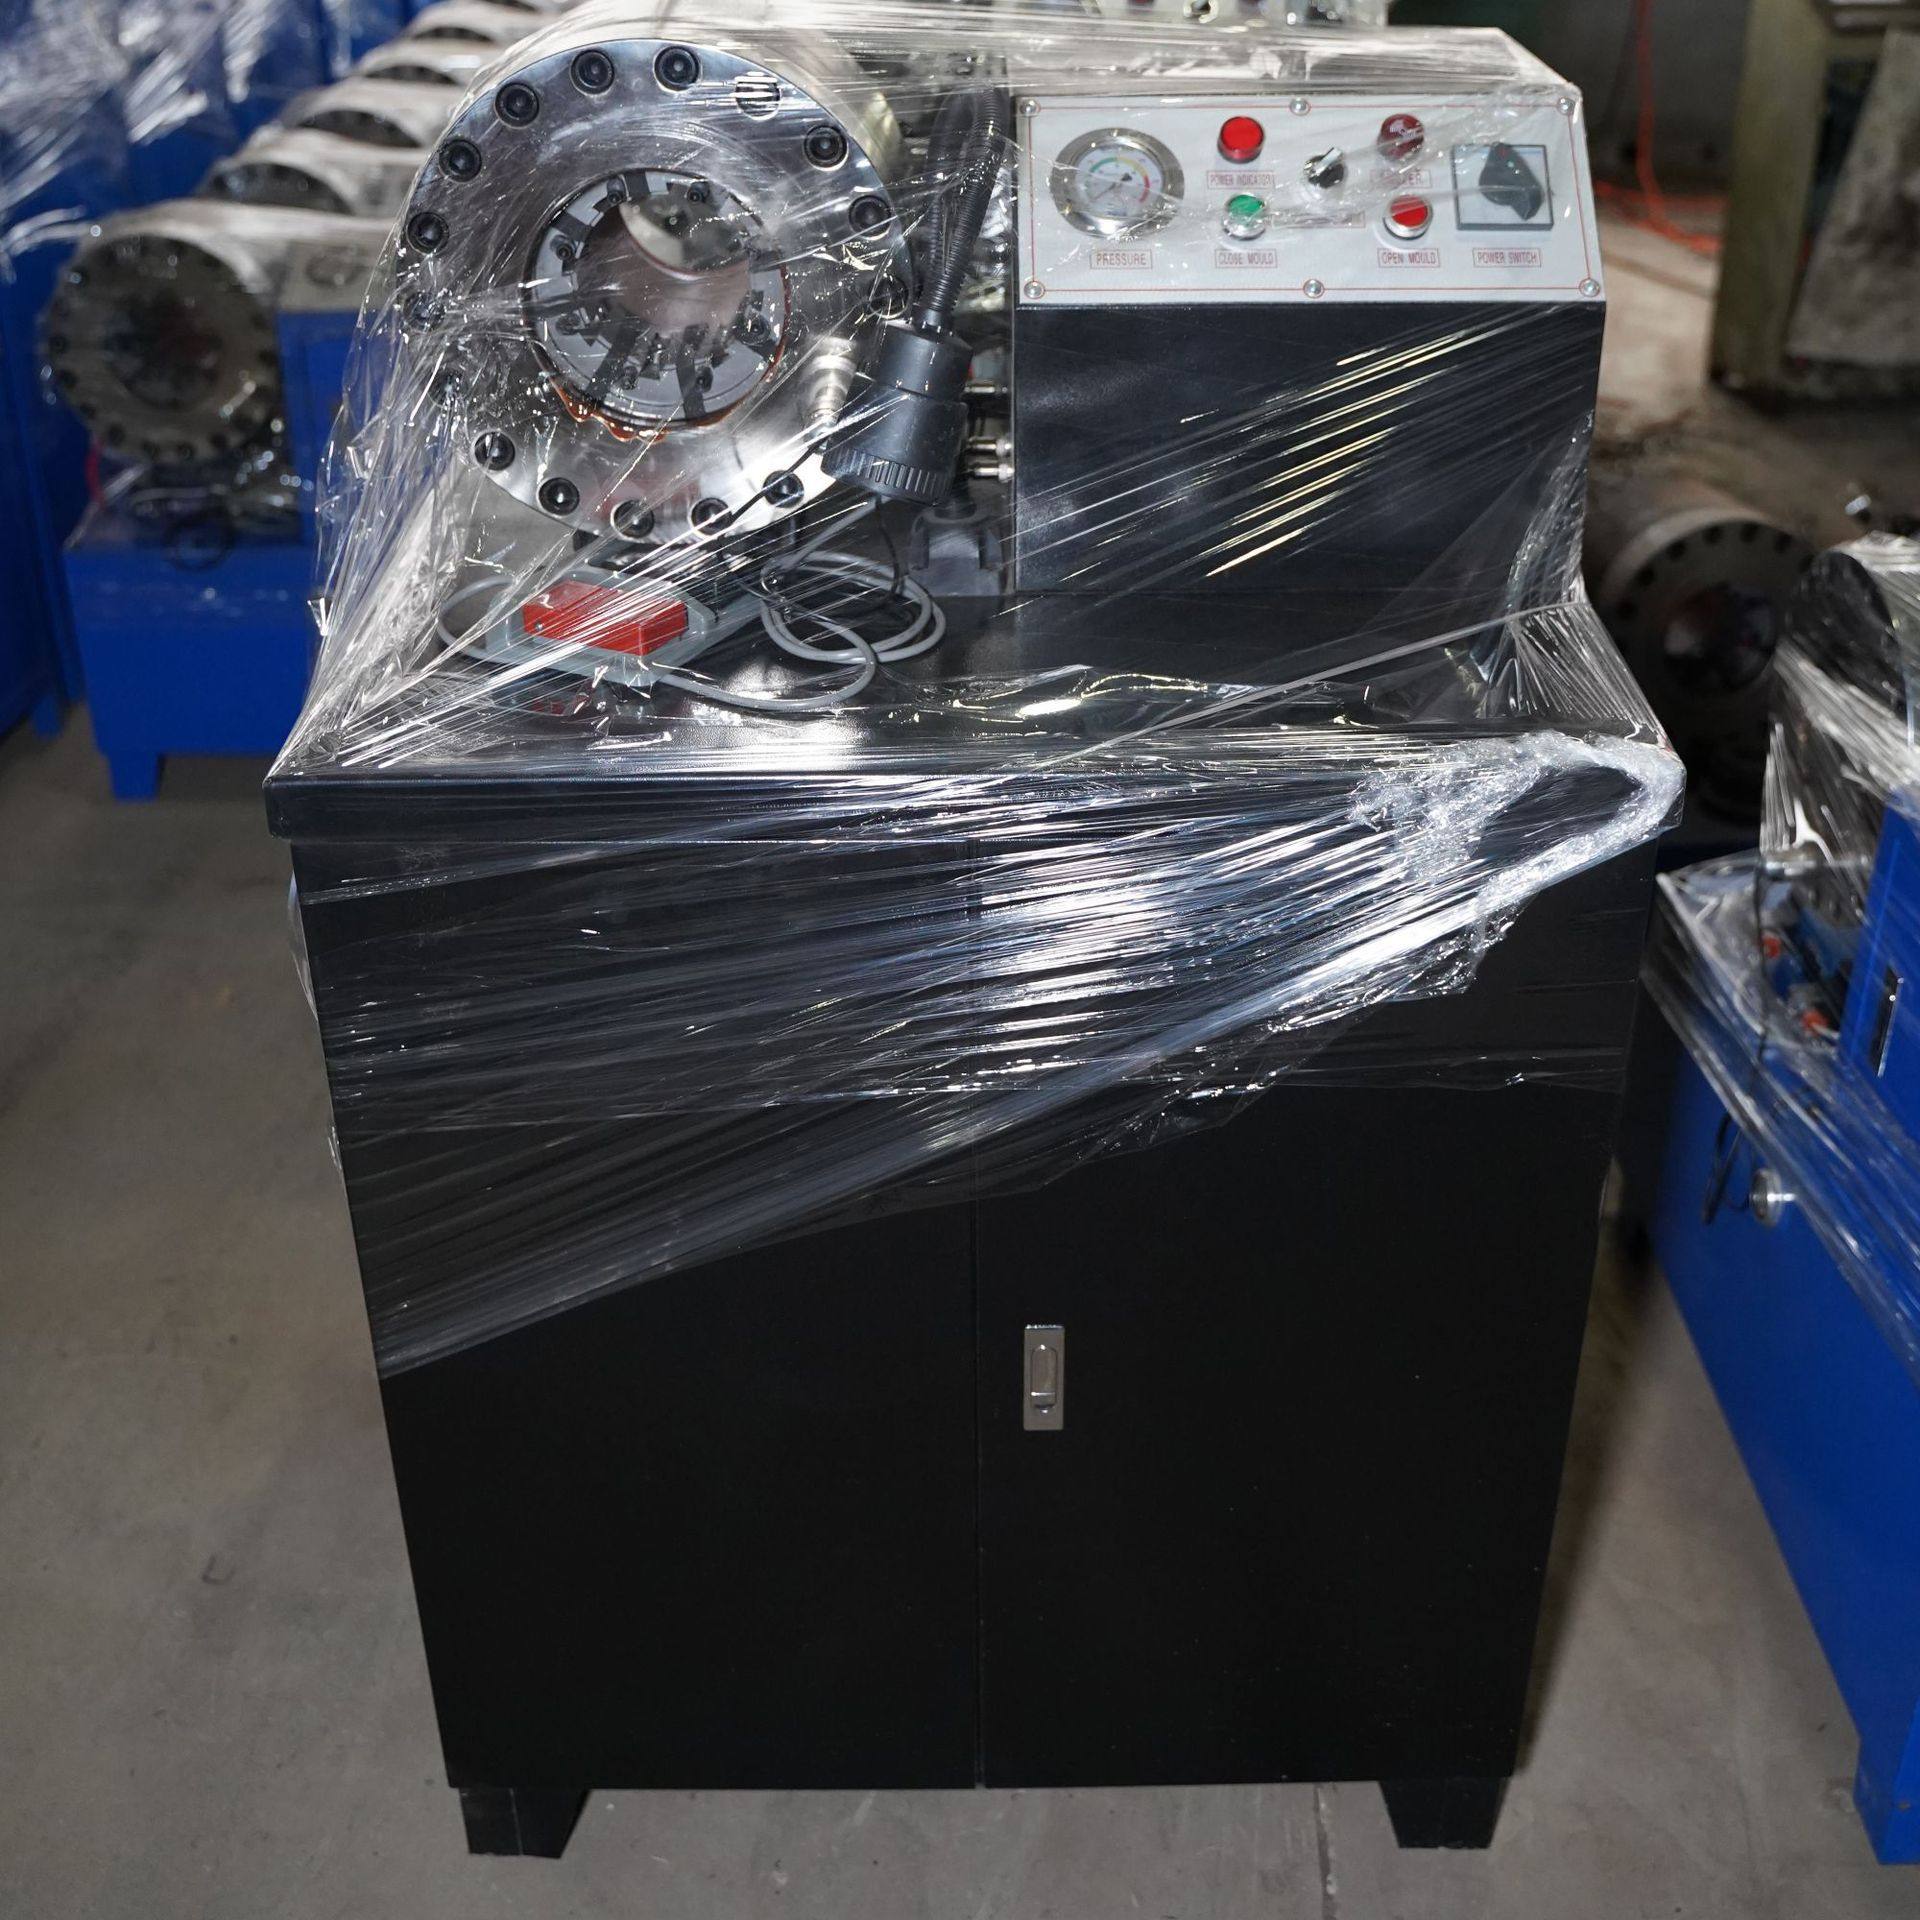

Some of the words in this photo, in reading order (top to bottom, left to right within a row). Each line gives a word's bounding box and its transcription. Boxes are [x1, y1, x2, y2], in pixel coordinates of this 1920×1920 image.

[1210, 173, 1234, 185] POWER
[1095, 252, 1147, 266] PRESSURE
[1218, 251, 1244, 265] CLOSE
[1247, 251, 1274, 265] MOULD
[1381, 251, 1404, 265] OPEN
[1408, 251, 1437, 265] MOULD
[1477, 251, 1505, 265] POWER
[1508, 251, 1538, 265] SWITCH
